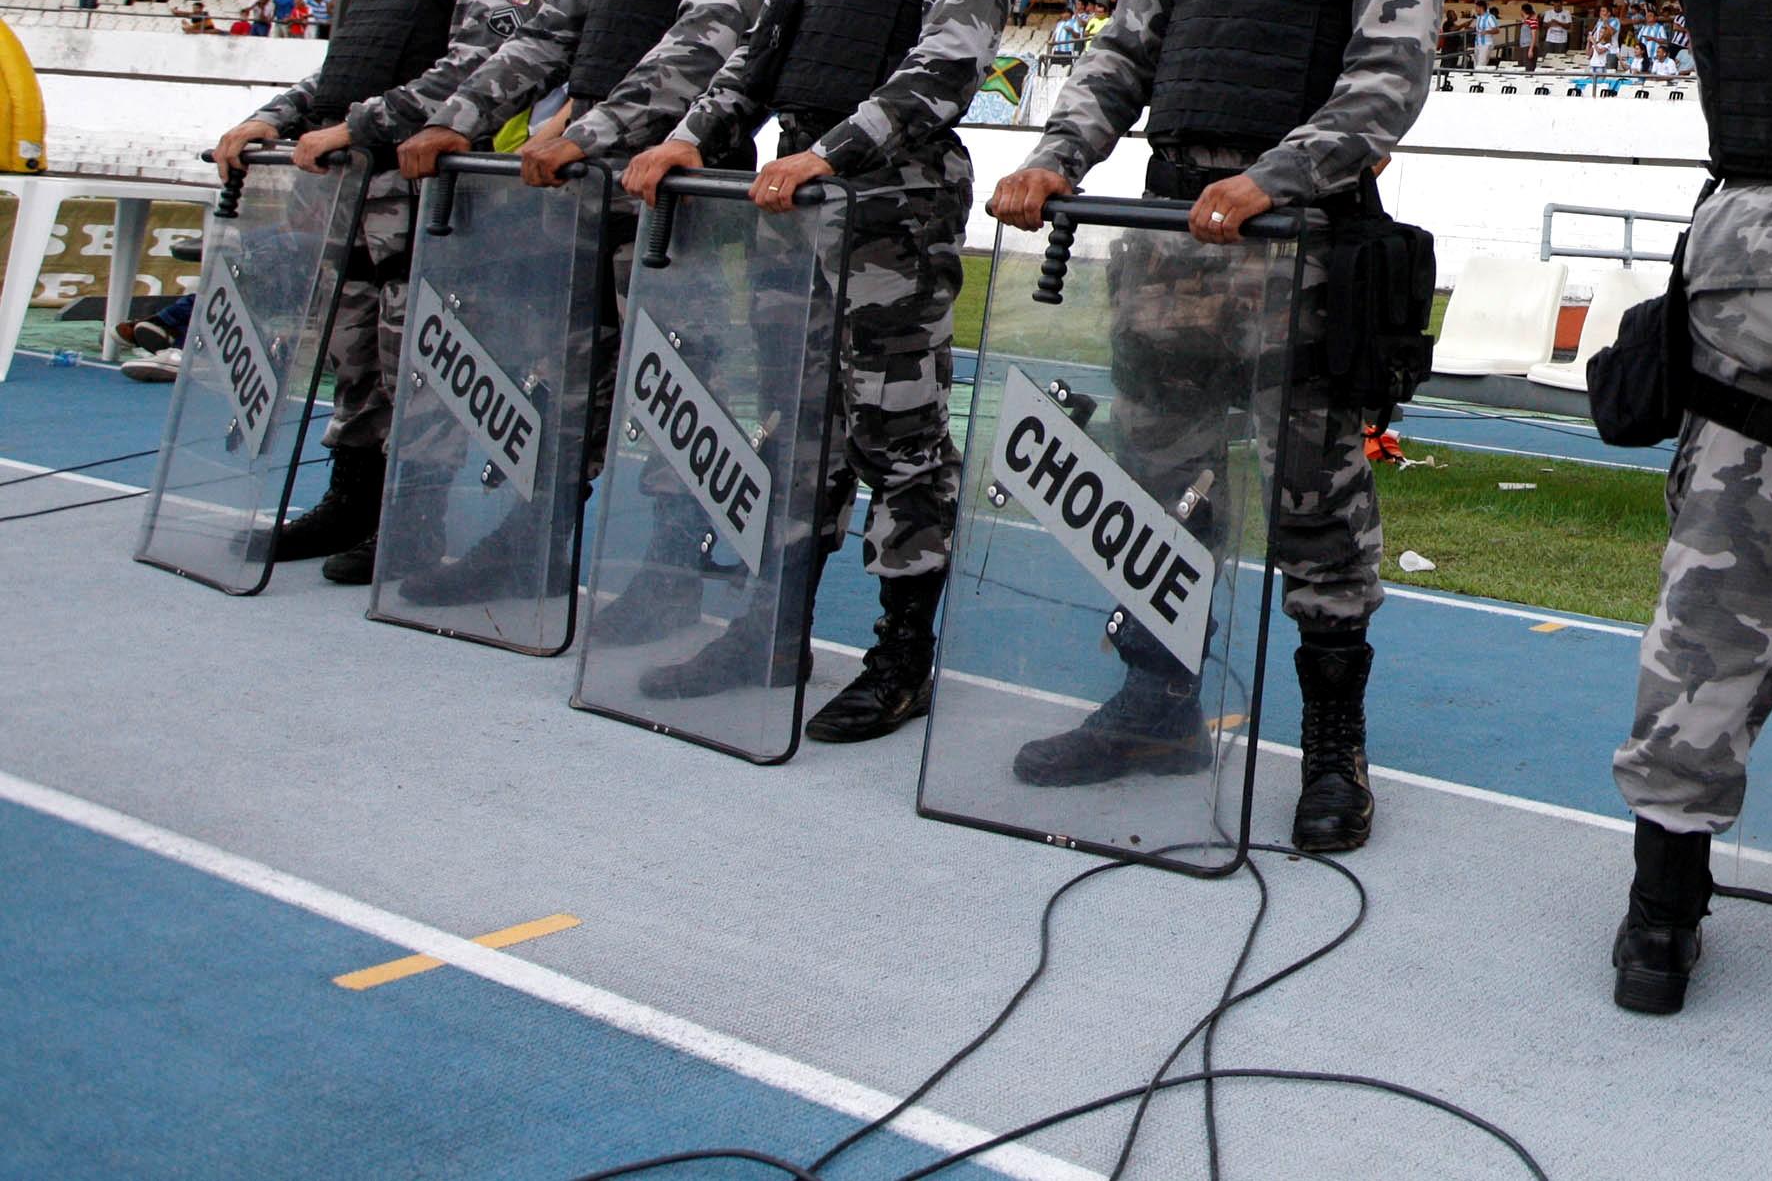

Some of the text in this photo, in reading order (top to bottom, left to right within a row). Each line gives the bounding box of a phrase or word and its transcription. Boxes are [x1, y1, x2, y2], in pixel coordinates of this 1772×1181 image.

[206, 286, 270, 430] CHOQUE
[417, 314, 533, 466] CHOQUE
[634, 351, 761, 534] CHOQUE
[1005, 415, 1201, 625] CHOQUE
